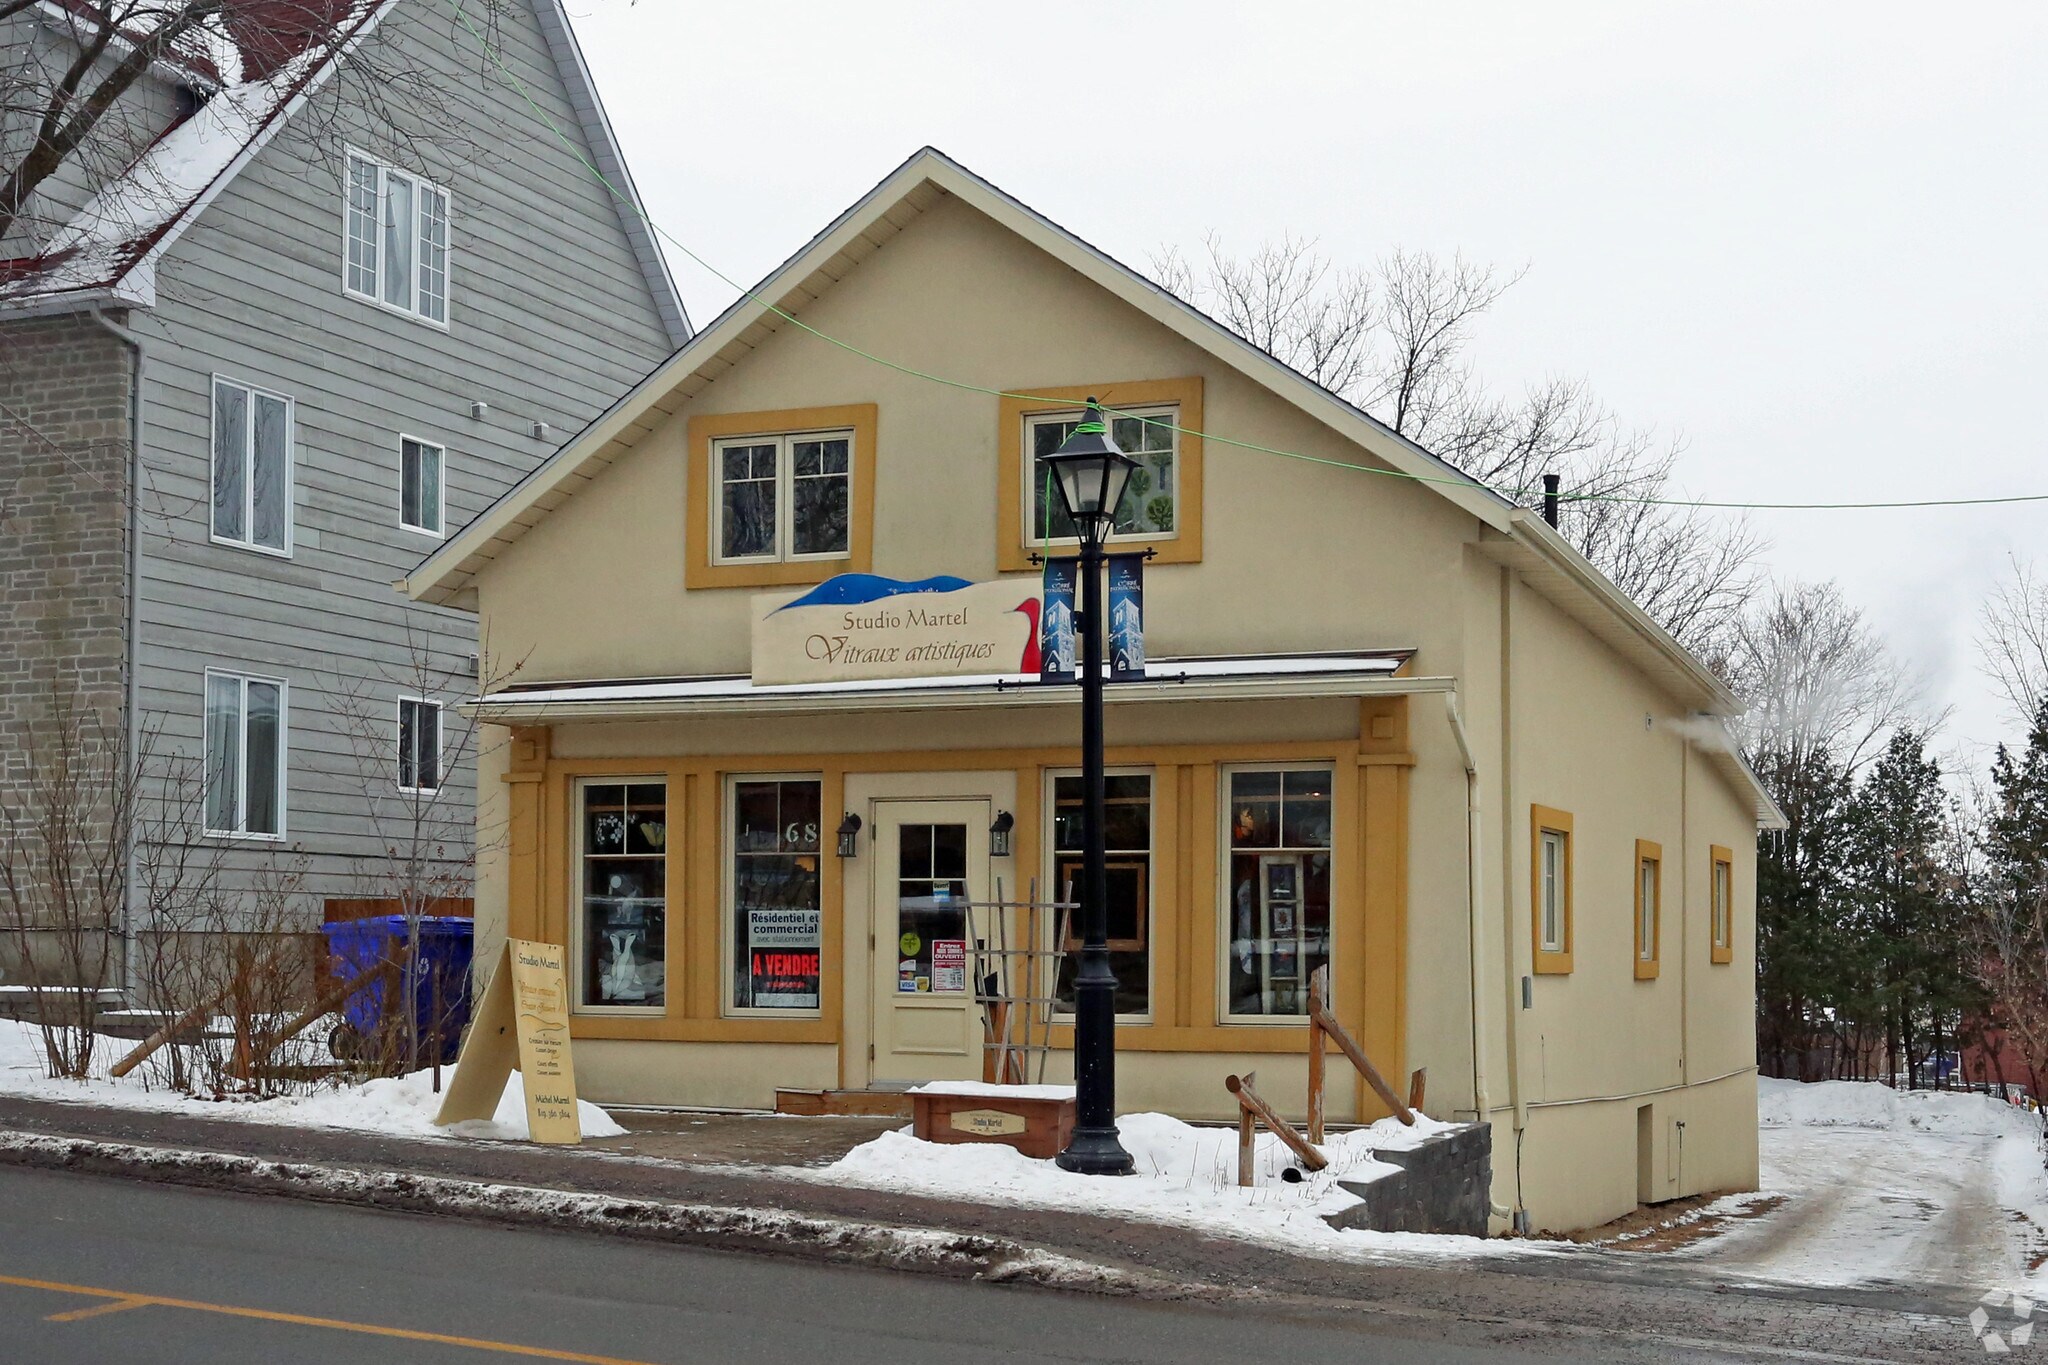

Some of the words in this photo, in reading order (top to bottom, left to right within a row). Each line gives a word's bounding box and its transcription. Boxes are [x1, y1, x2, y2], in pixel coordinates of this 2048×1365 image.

[843, 611, 900, 631] Studio
[905, 607, 968, 629] Martel
[805, 634, 900, 664] Vitraux
[905, 640, 996, 668] artistiques
[751, 912, 805, 923] Résidentiel
[809, 914, 819, 923] et
[753, 924, 818, 934] commercial
[518, 952, 539, 967] Studio
[539, 956, 560, 970] Martel
[753, 954, 762, 976] A
[765, 954, 819, 976] VENDRE
